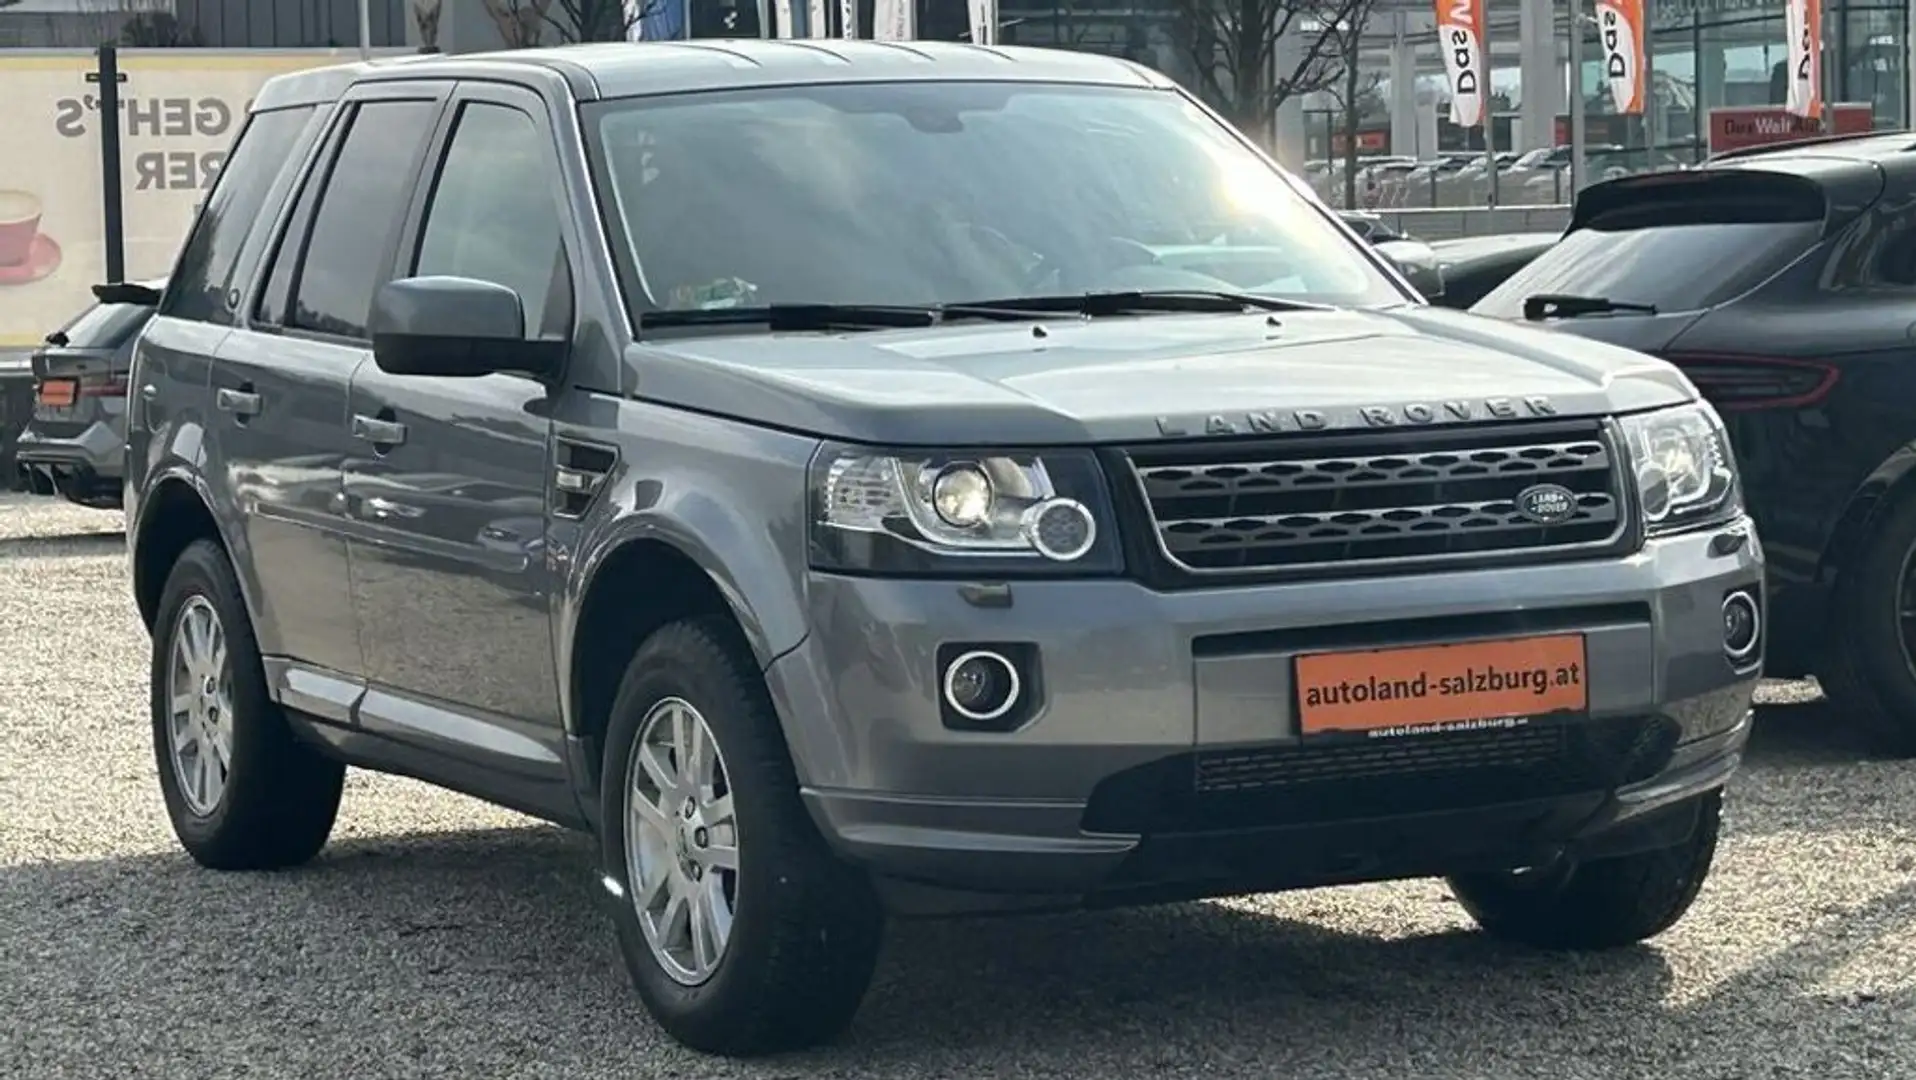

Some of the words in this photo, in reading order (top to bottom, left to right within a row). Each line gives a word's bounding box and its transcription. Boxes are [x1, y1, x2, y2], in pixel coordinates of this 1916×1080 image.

[1155, 409, 1328, 437] LAND
[1358, 395, 1557, 427] ROVER
[1306, 661, 1580, 708] autoland-salzburg.at
